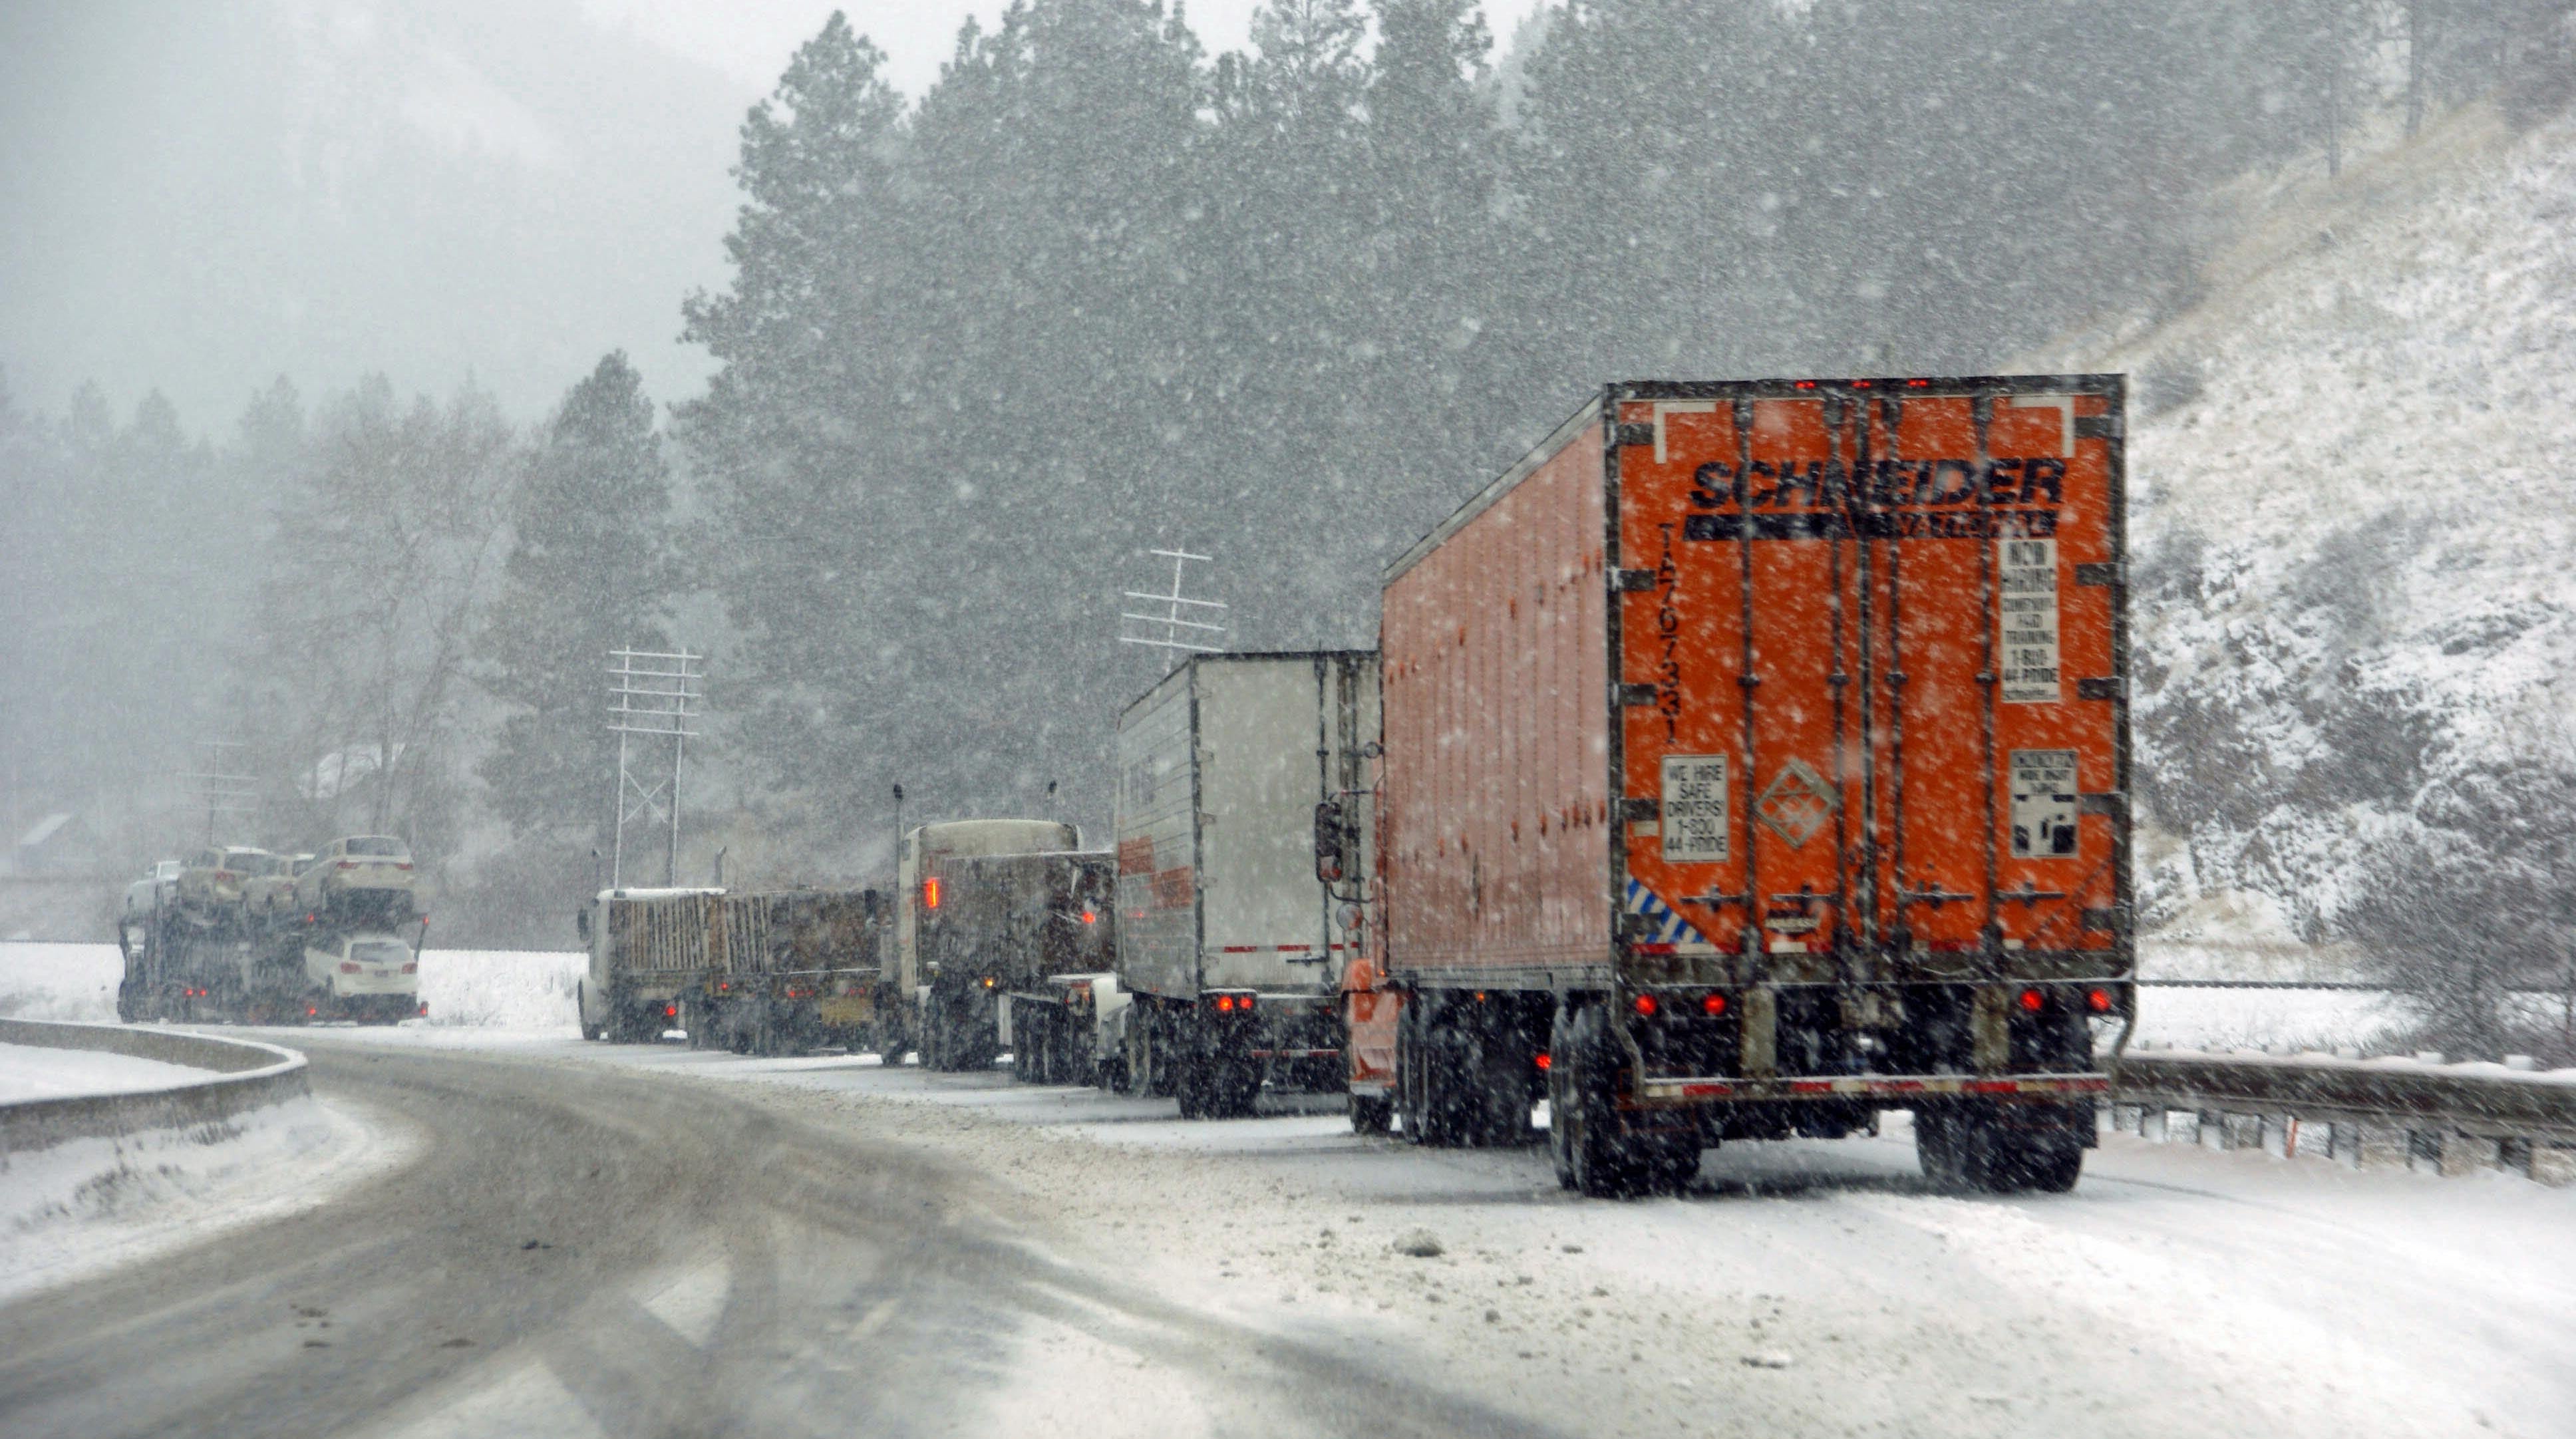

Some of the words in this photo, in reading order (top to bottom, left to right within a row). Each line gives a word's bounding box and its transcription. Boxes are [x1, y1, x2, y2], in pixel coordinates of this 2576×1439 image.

[1689, 457, 2066, 510] SCHNEIDER
[1668, 765, 1687, 782] WE
[1694, 764, 1722, 781] HIRE
[1680, 782, 1711, 799] SAFE
[1667, 800, 1723, 817] DRIVERS
